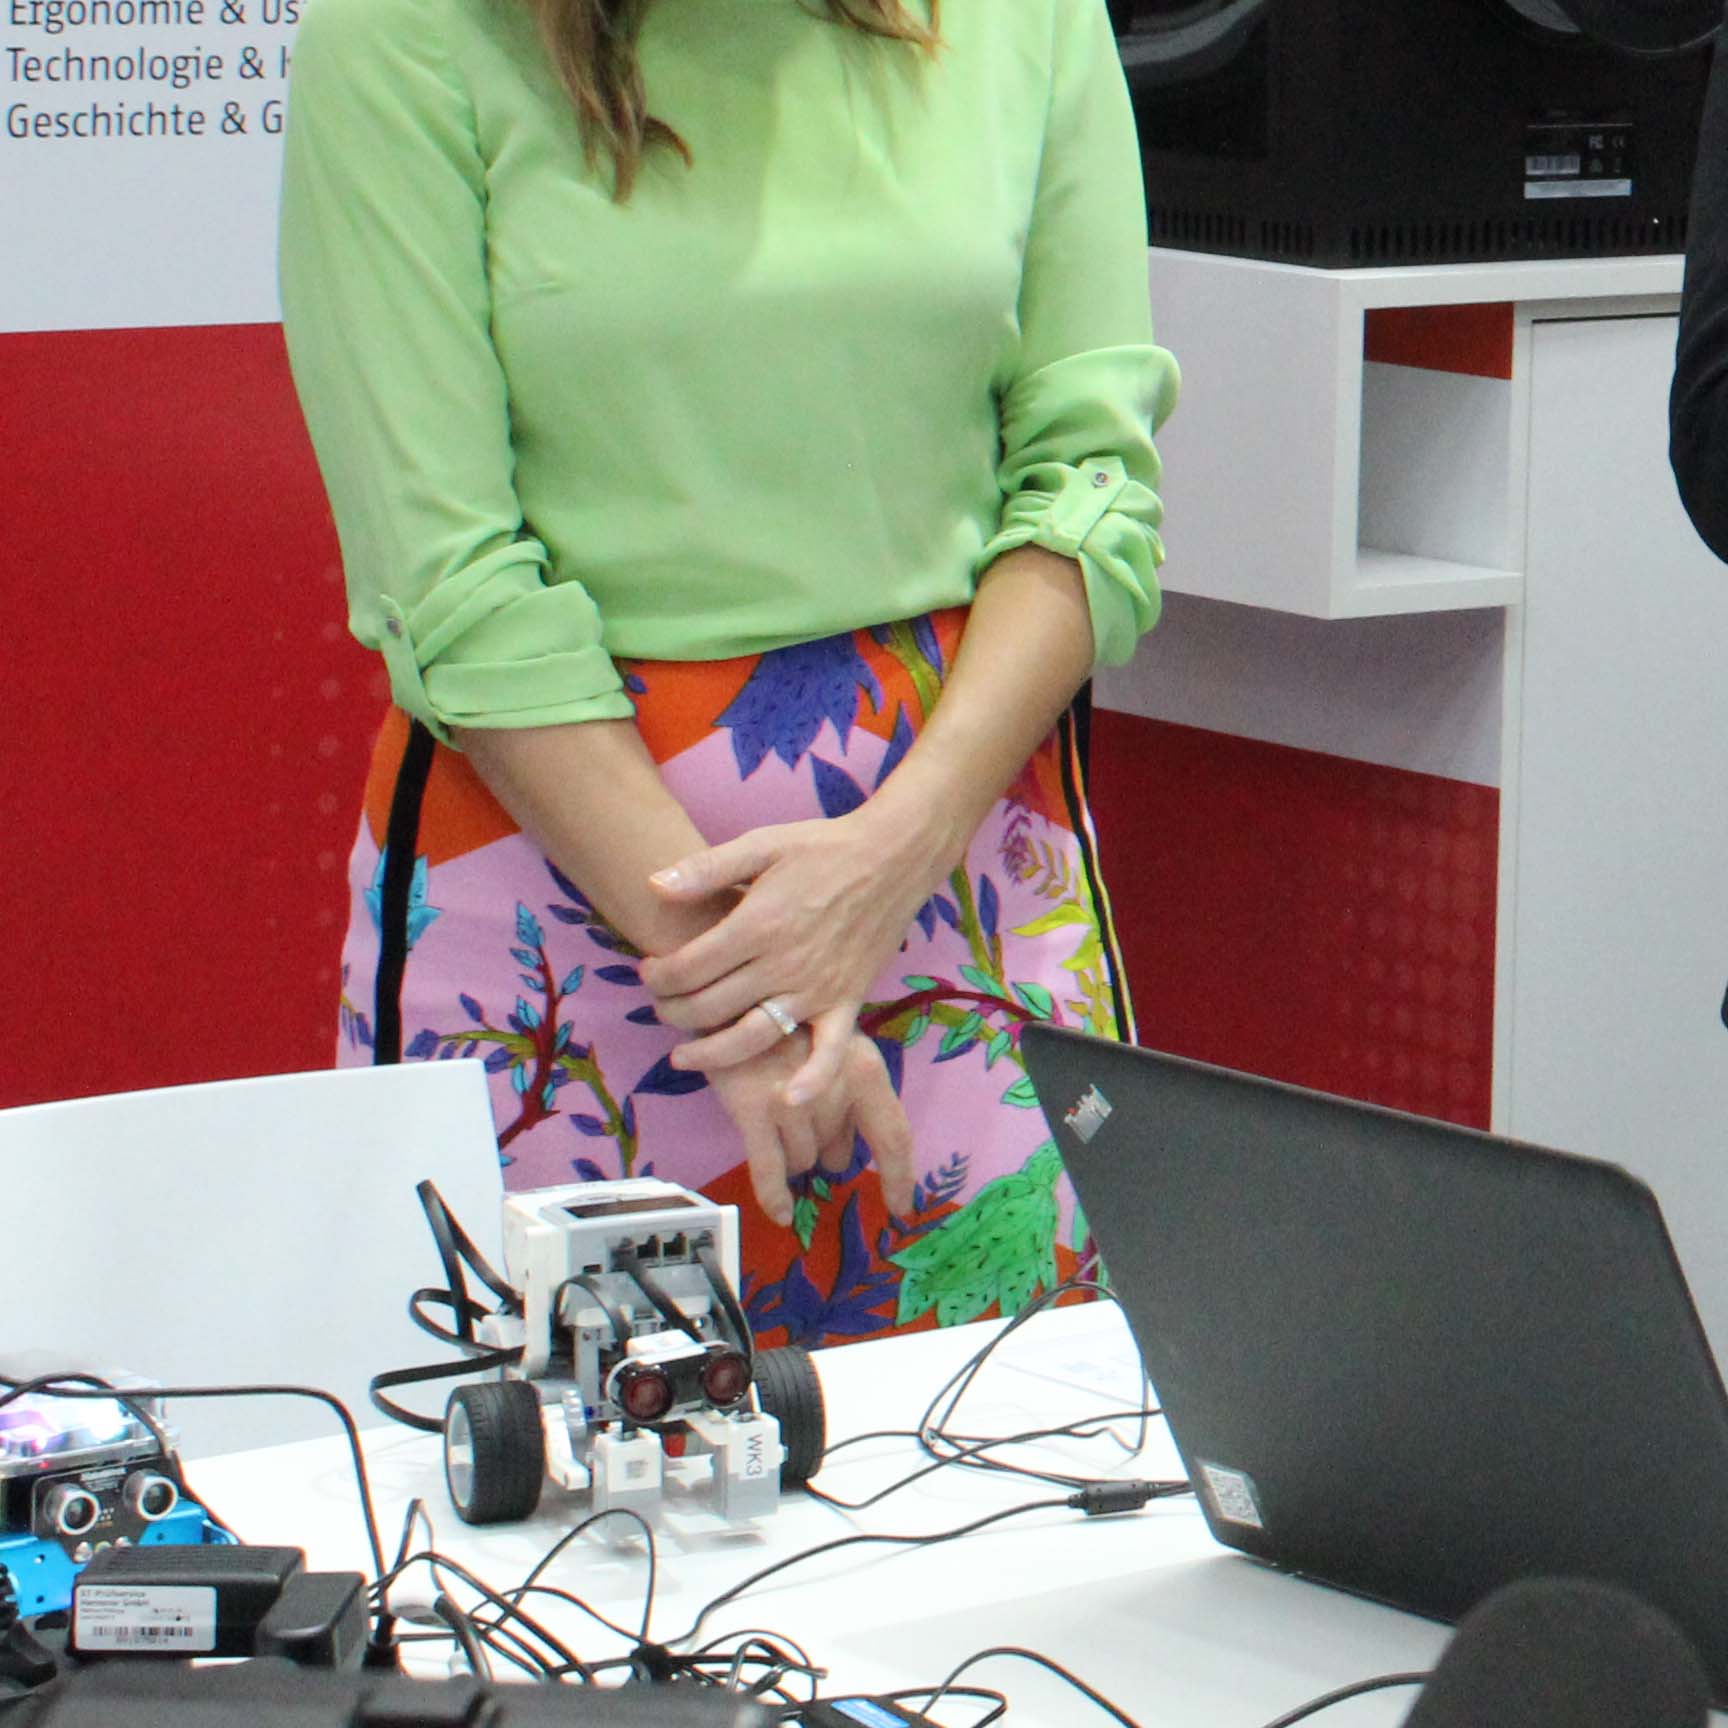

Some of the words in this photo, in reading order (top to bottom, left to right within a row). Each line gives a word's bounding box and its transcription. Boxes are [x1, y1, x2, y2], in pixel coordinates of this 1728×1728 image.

[8, 46, 223, 89] Technologie
[238, 46, 265, 81] &
[7, 100, 206, 140] Geschichte
[220, 100, 248, 136] &
[745, 1433, 764, 1478] WK3
